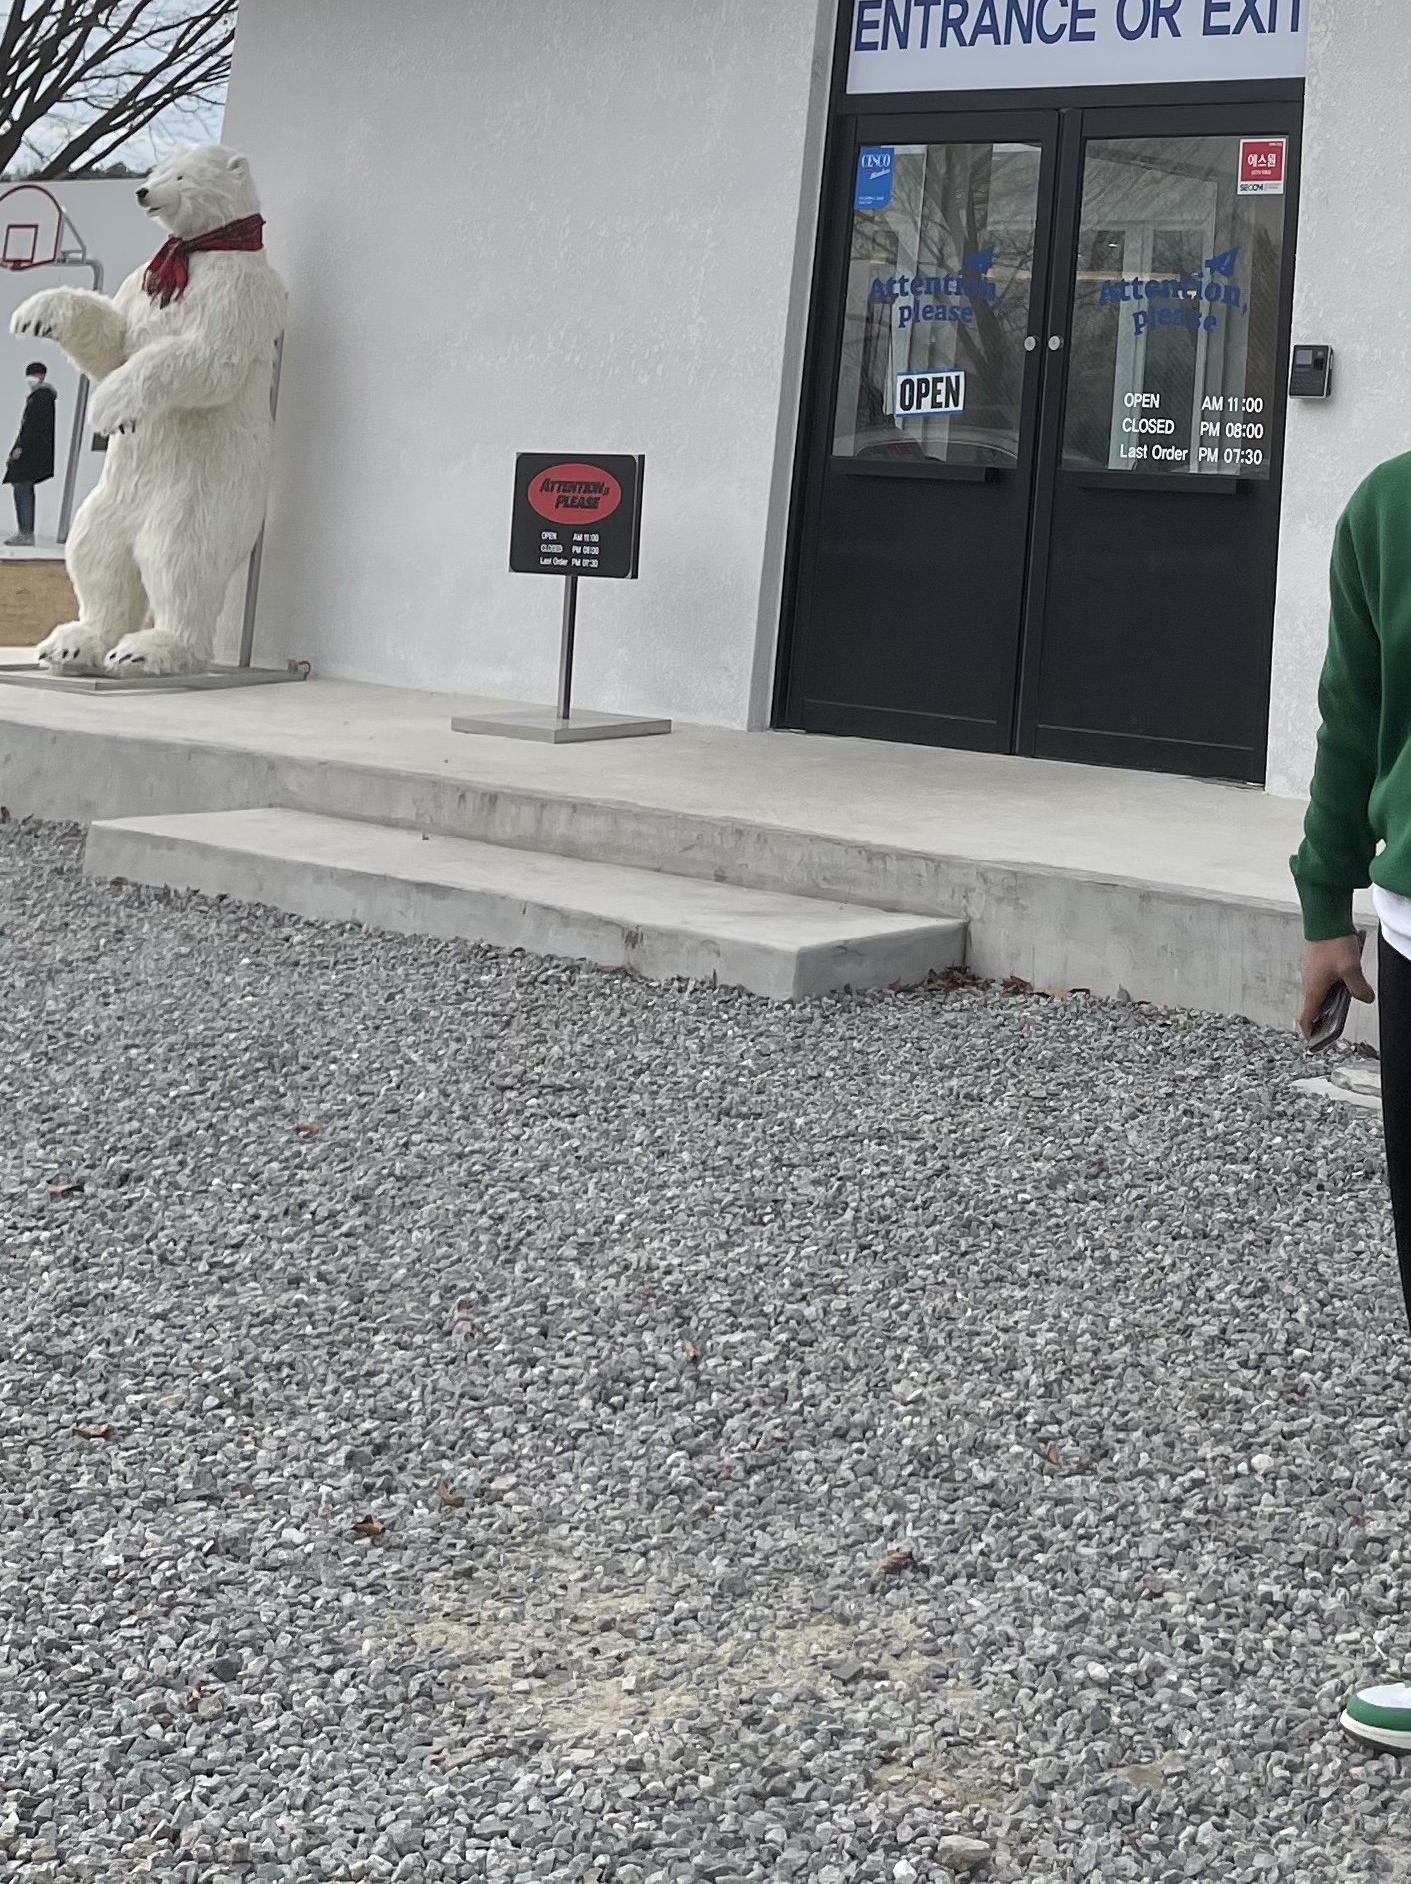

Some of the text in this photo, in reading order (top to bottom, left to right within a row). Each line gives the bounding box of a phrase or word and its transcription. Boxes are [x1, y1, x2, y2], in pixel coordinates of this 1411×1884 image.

[1247, 153, 1277, 167] 에스원
[899, 296, 973, 328] please
[900, 375, 960, 411] OPEN
[1124, 392, 1263, 413] OPEN AM 11:00
[1122, 417, 1264, 439] CLOSED PM 08:00
[1120, 444, 1263, 465] Last Order PM 07:30
